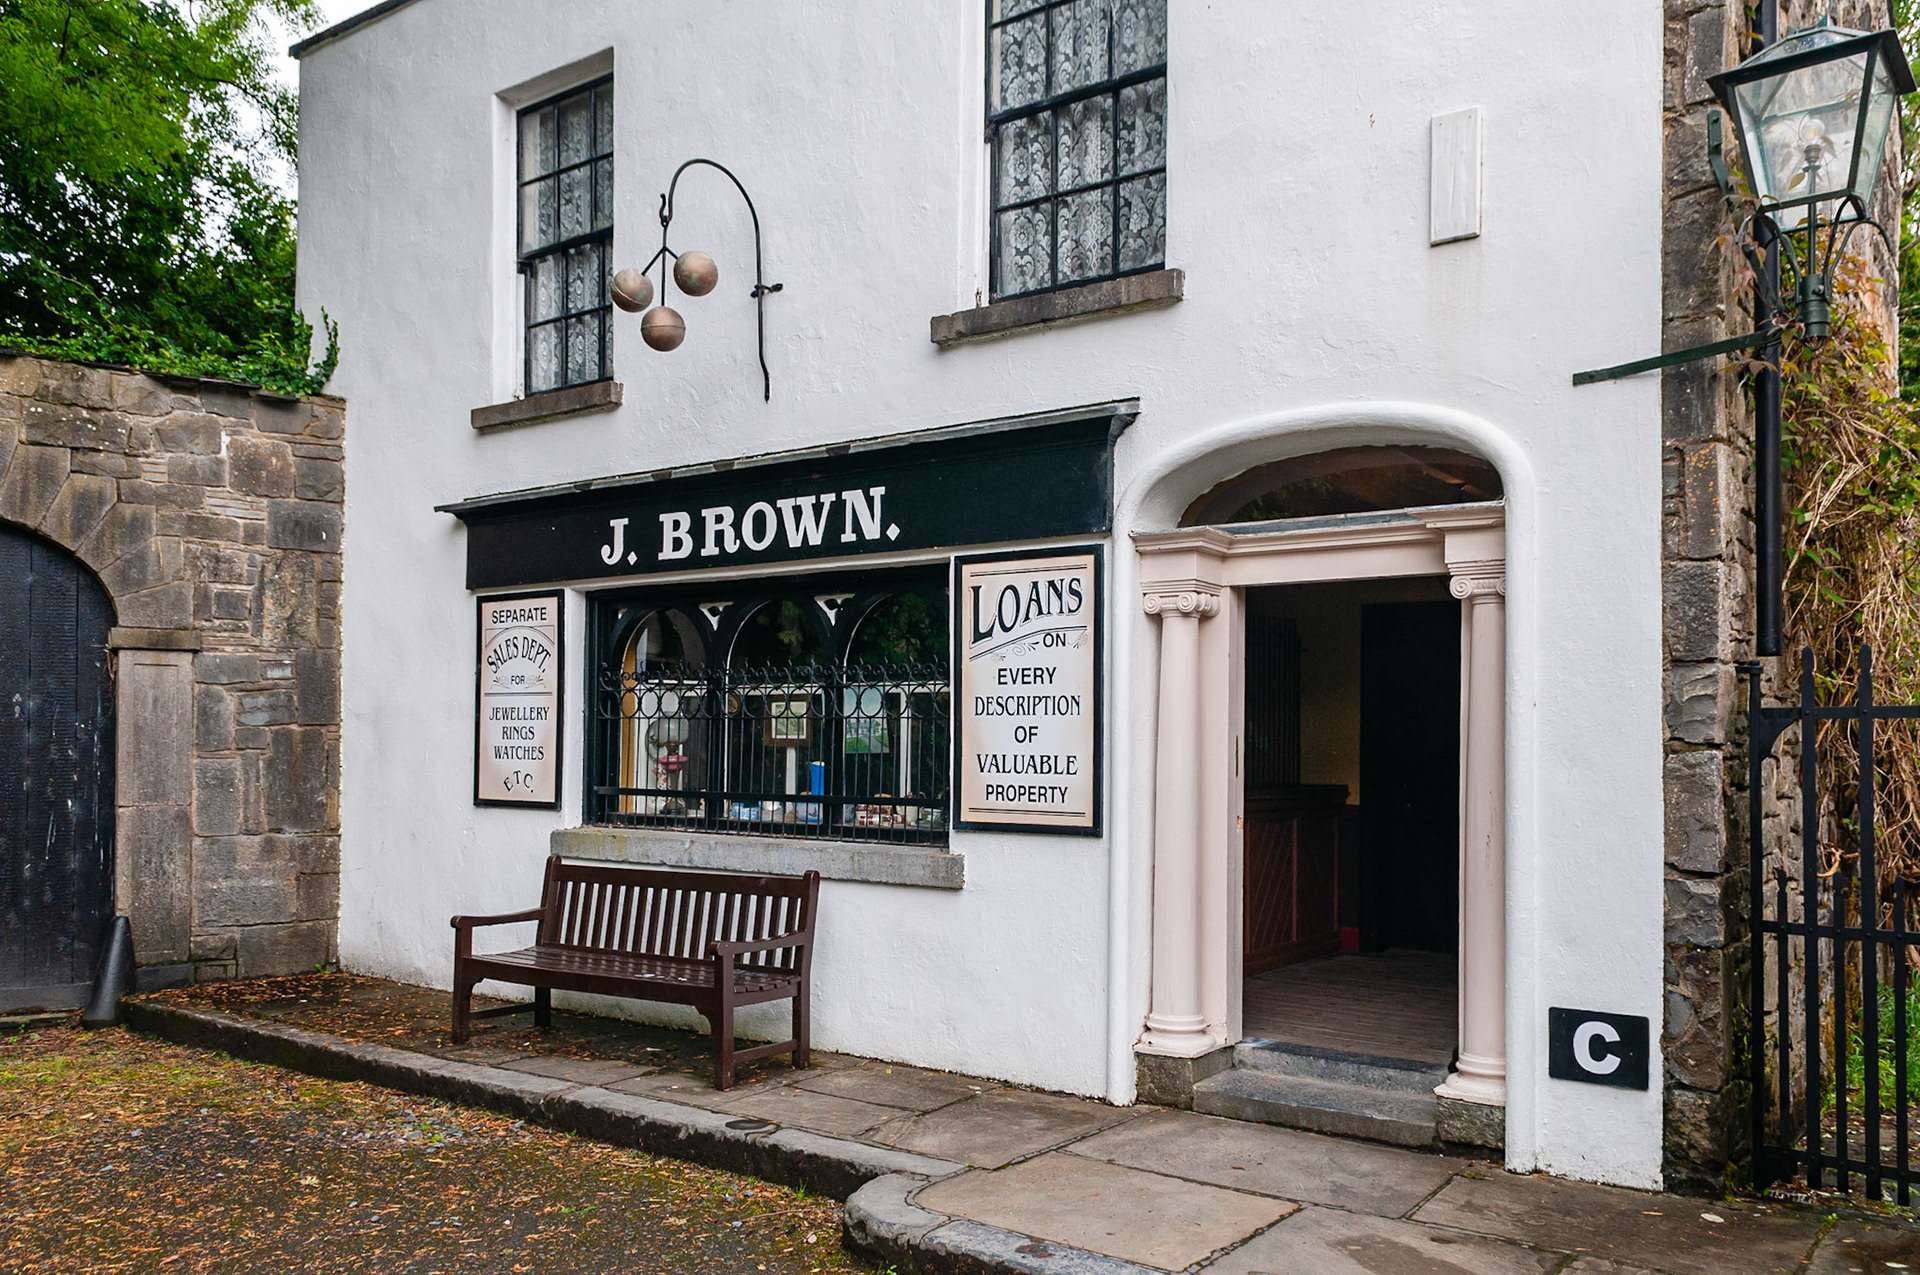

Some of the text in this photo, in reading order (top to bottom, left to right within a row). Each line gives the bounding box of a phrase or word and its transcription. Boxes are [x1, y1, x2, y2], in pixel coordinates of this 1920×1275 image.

[600, 486, 901, 566] J. BROWN.
[491, 606, 547, 624] SEPARATE
[969, 577, 1083, 648] LOANS
[1042, 632, 1066, 648] ON
[486, 636, 551, 674] SALES DEPT.
[510, 675, 525, 685] FOR
[997, 666, 1057, 685] EVERY
[488, 706, 550, 721] JEWELLERY
[974, 695, 1081, 716] DESCRIPTION
[501, 725, 535, 740] RINGS
[1014, 725, 1039, 744] OF
[493, 745, 545, 760] WATCHES
[976, 753, 1078, 775] VALUABLE
[503, 770, 534, 793] ETC.
[985, 784, 1068, 804] PROPERTY
[1572, 1020, 1621, 1075] C
